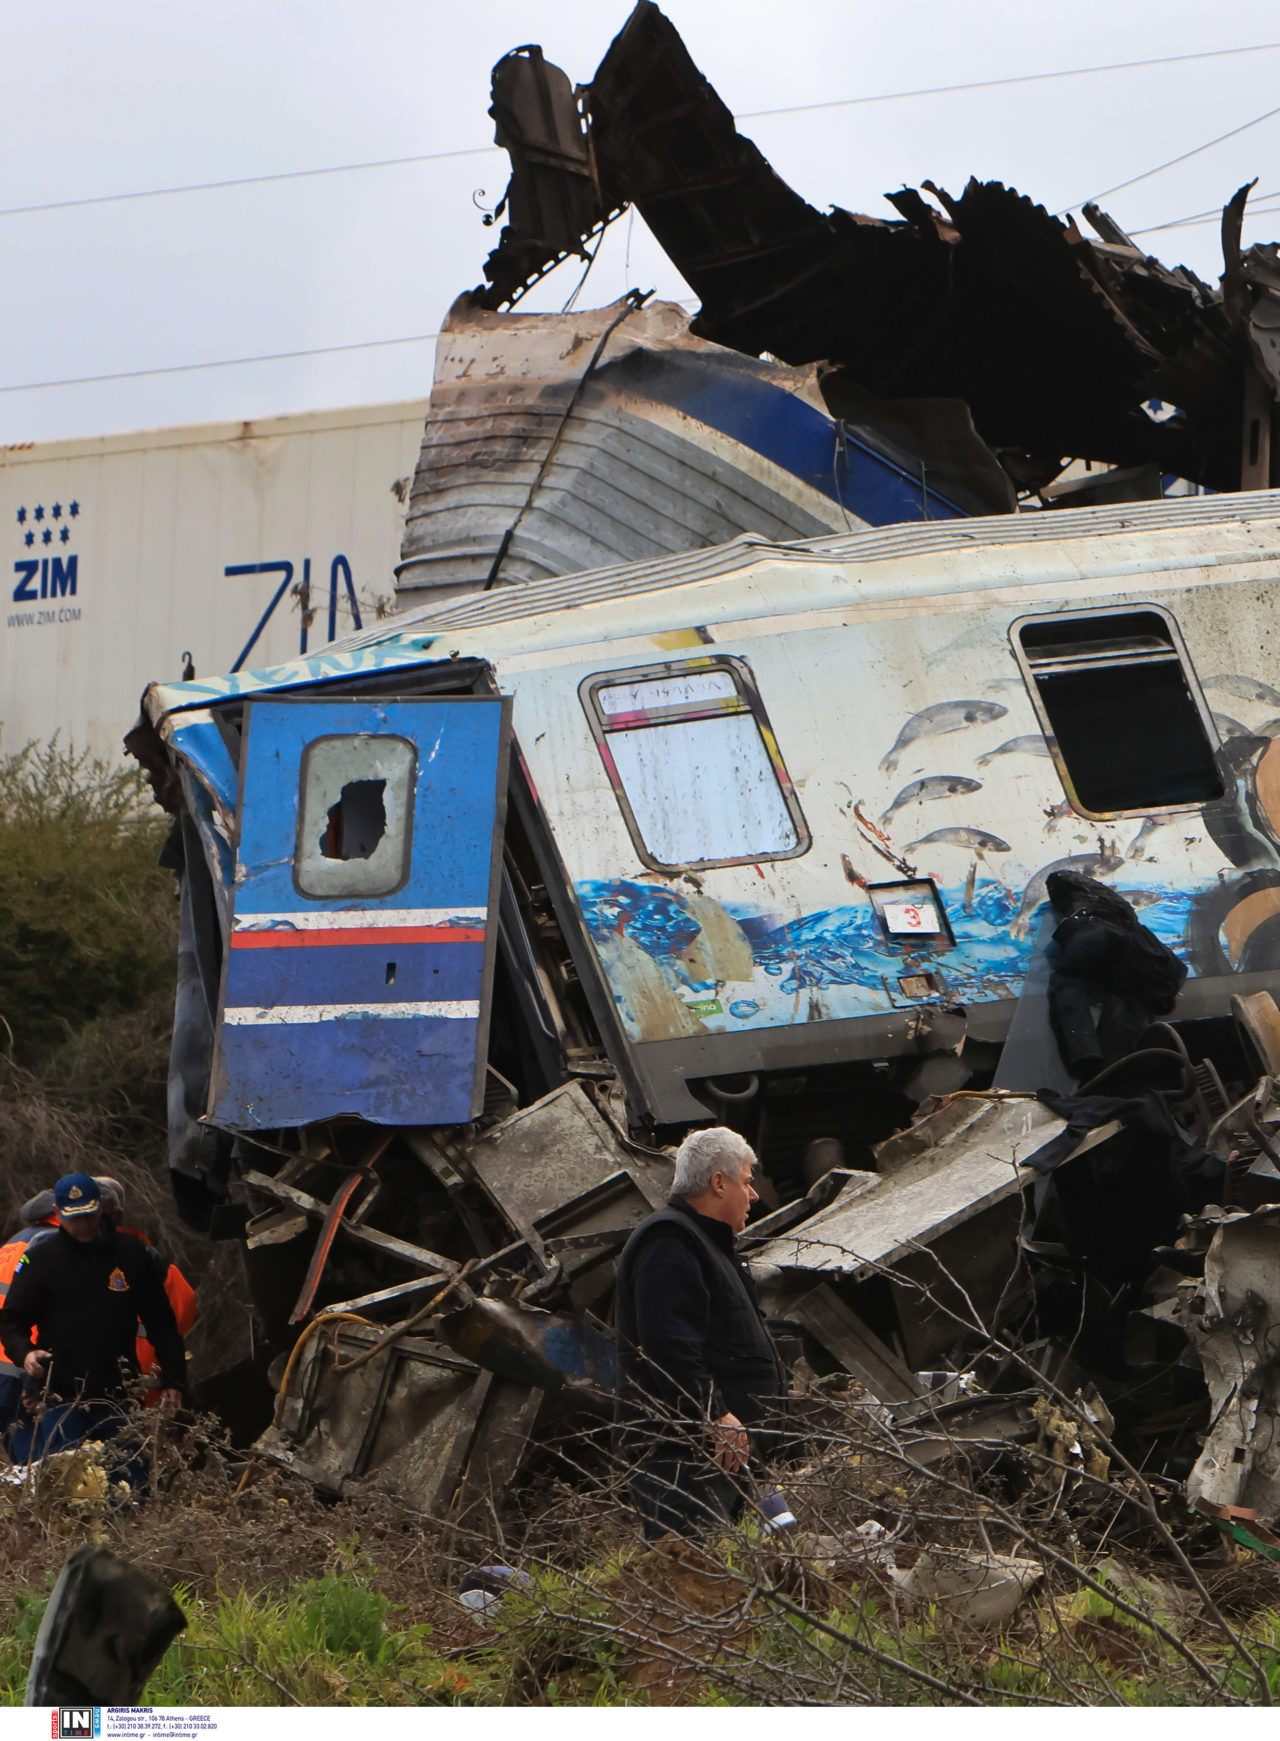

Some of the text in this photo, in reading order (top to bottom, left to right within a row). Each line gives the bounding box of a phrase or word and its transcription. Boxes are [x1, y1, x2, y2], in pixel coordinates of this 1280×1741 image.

[13, 554, 78, 602] ZIM
[7, 607, 82, 628] WWW.ZIM.COM
[904, 908, 921, 927] 3
